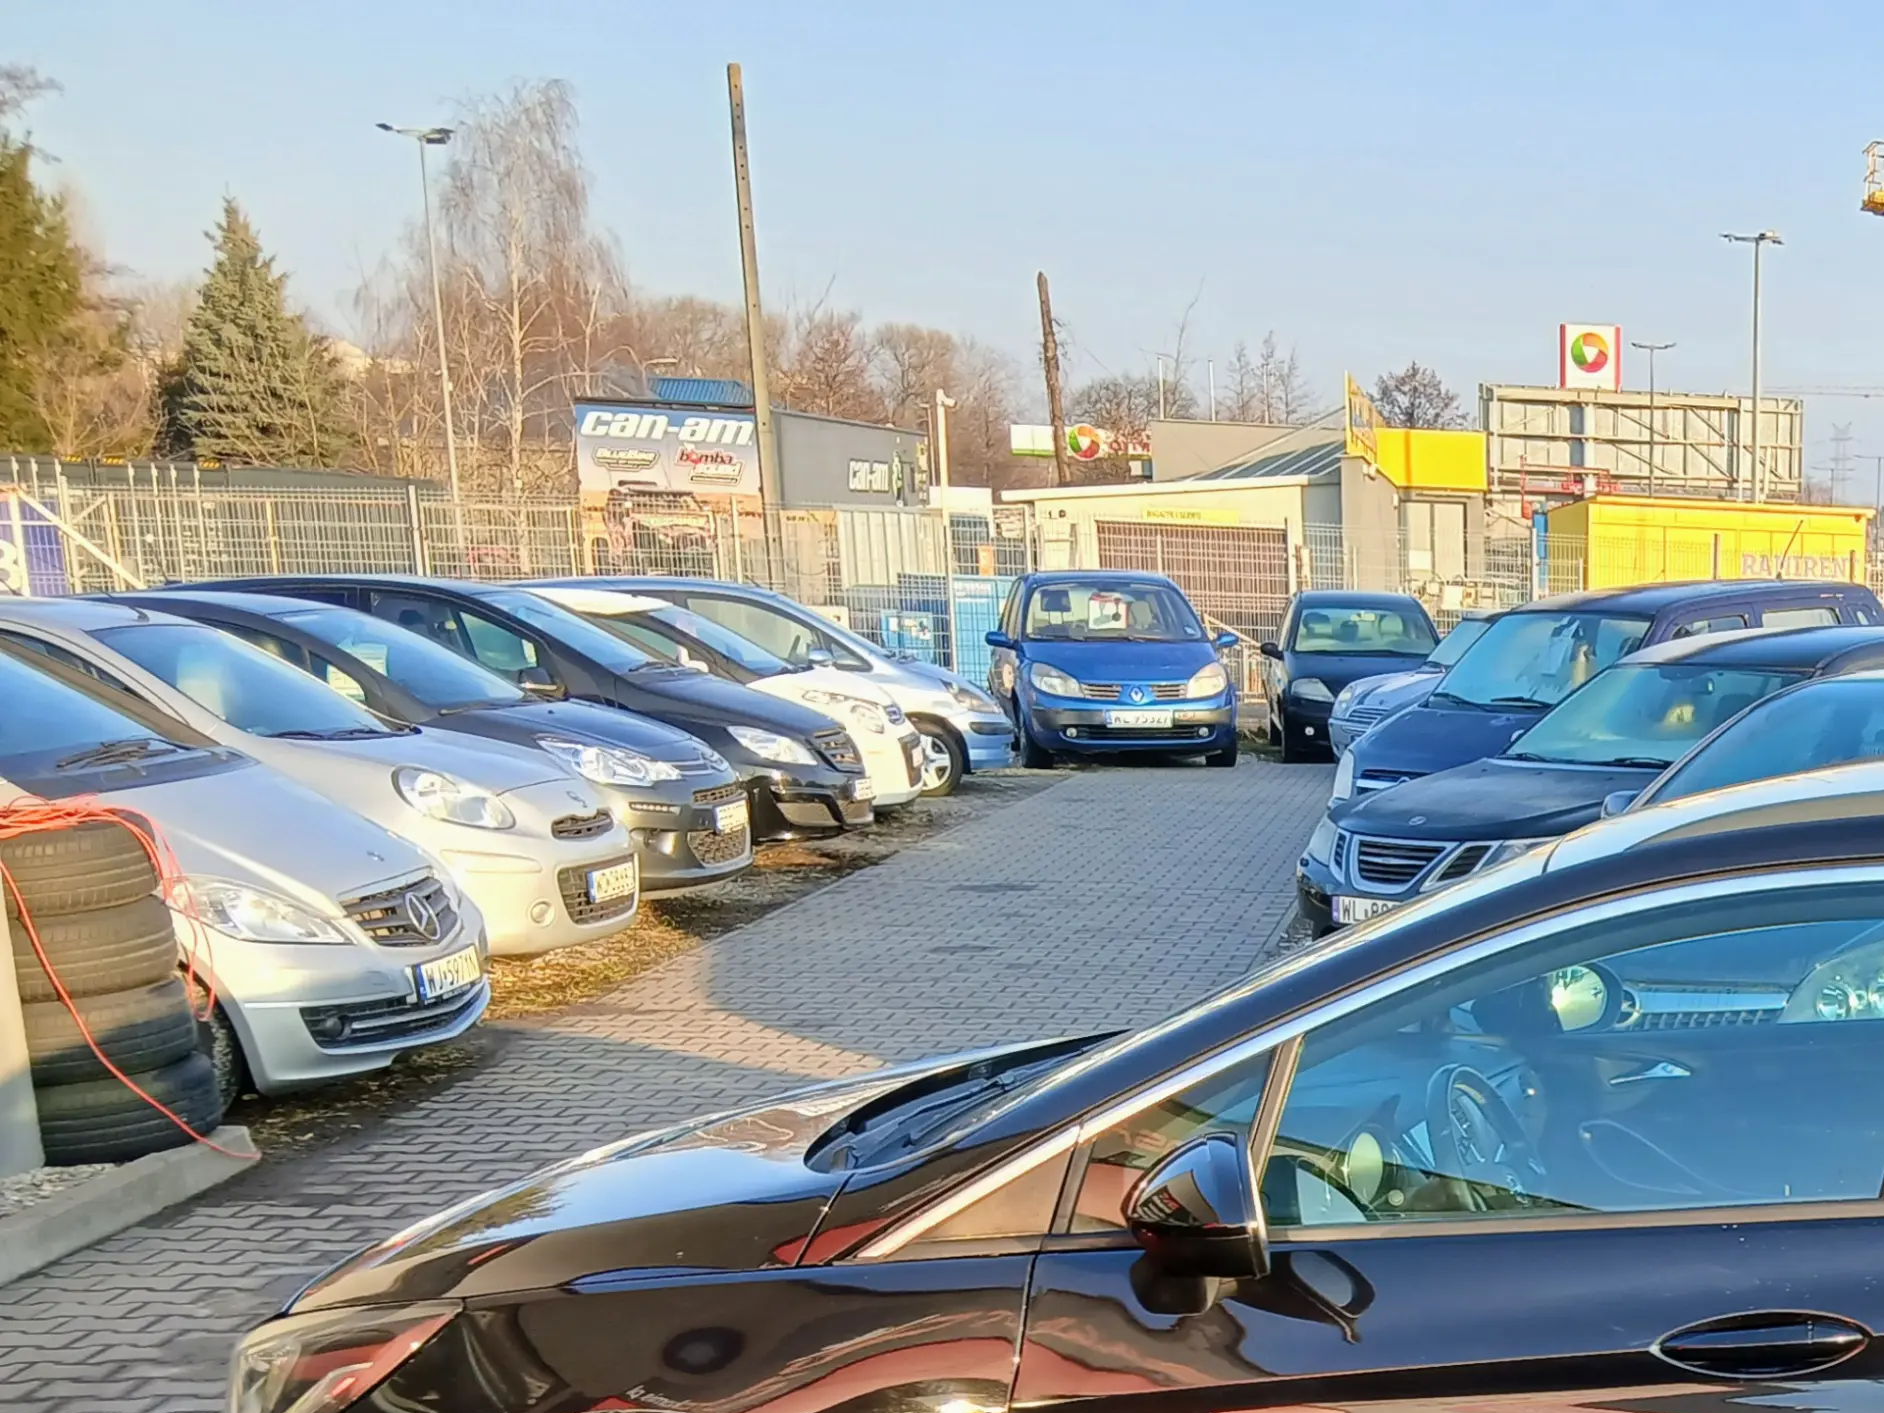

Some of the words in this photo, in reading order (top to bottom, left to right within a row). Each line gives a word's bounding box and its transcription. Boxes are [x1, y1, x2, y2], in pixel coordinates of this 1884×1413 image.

[580, 411, 755, 446] can-am
[1742, 553, 1860, 578] RAMIREN
[1342, 898, 1360, 921] WL
